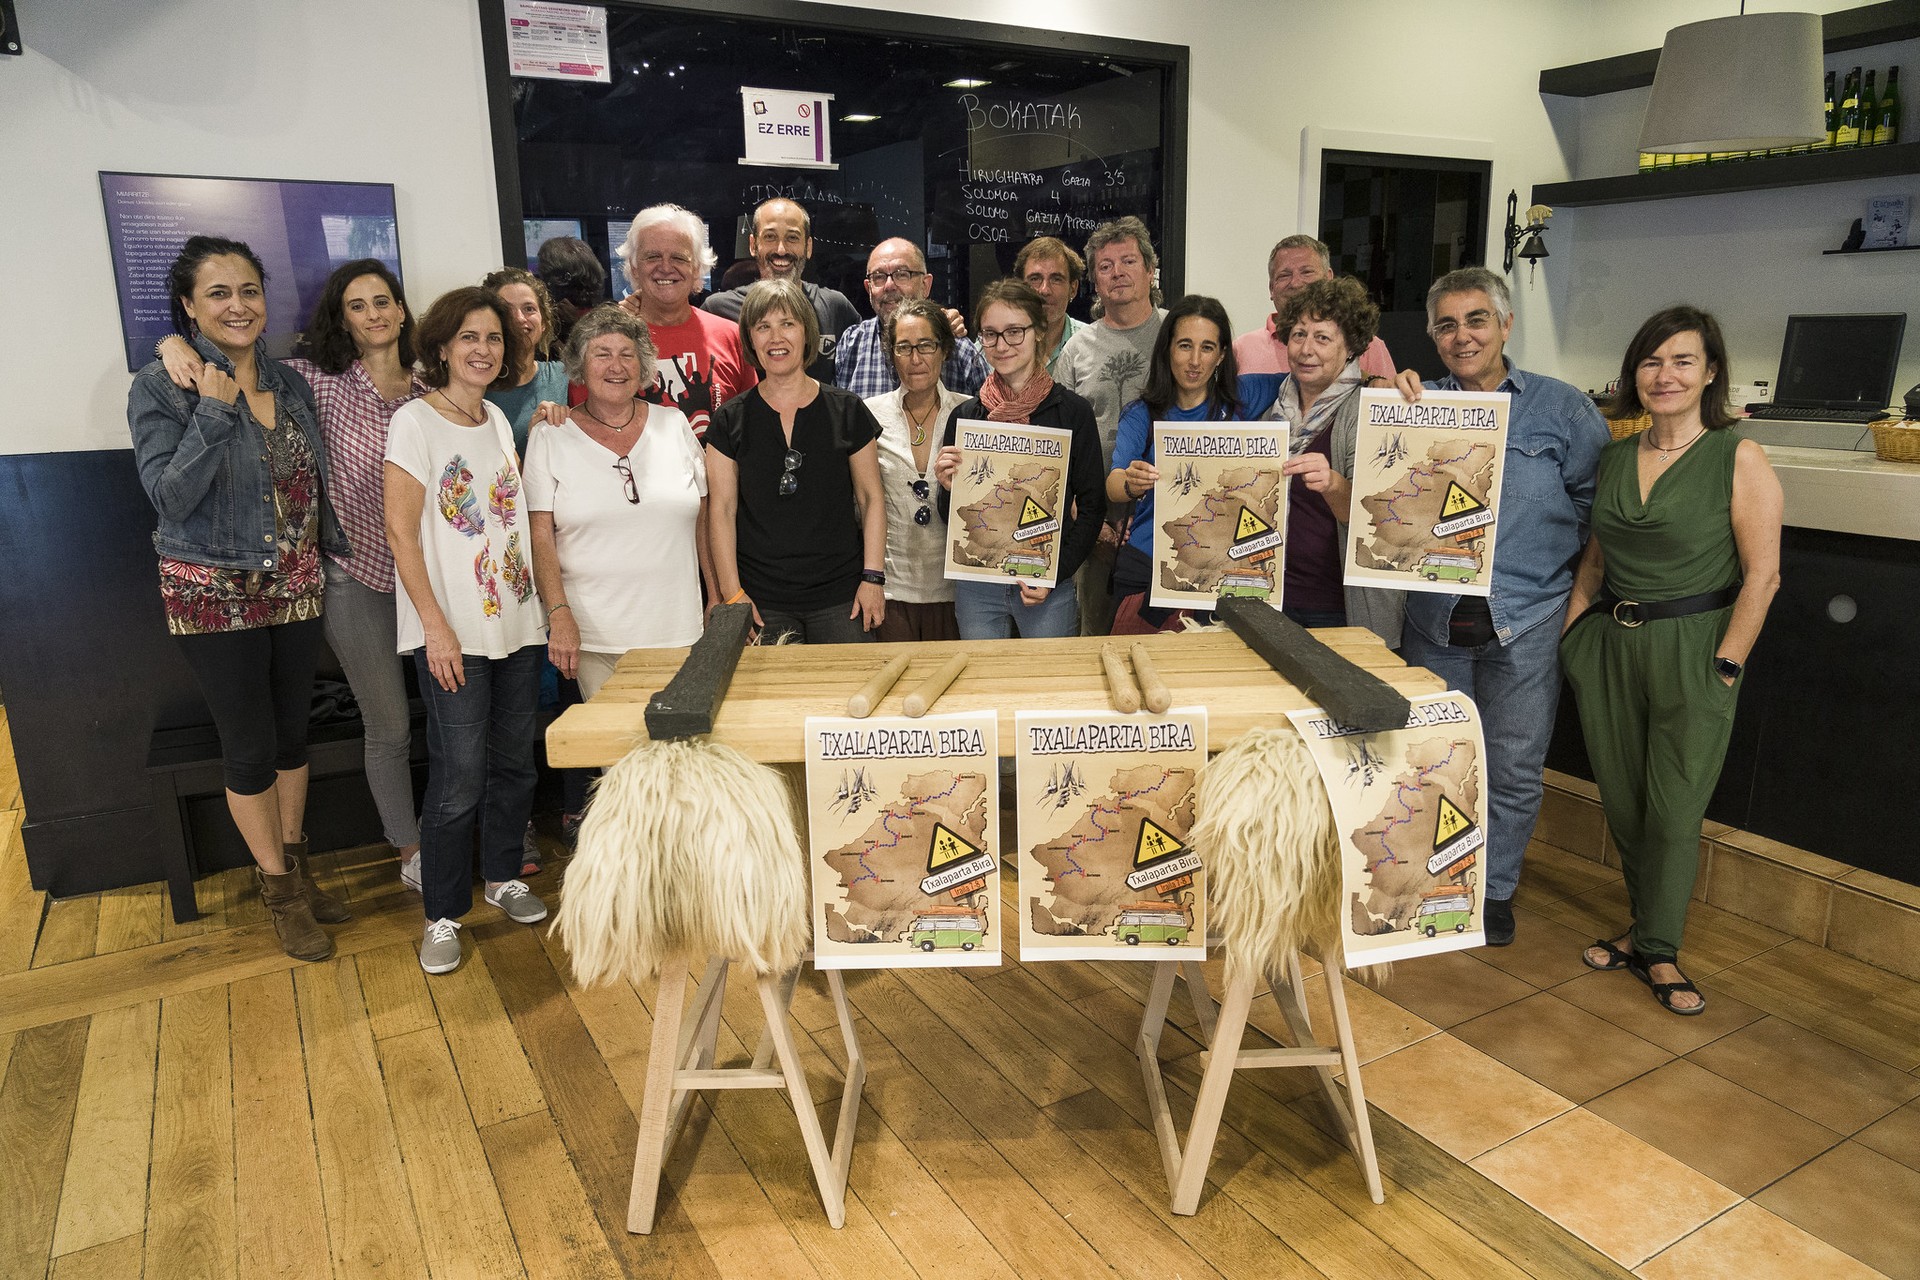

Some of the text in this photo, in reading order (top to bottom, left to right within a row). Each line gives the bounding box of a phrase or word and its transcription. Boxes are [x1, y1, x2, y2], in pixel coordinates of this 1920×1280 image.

[958, 94, 1081, 132] BOKATAK
[758, 123, 810, 136] EZ ERRE
[961, 184, 1061, 205] SOLOMOA 4
[965, 203, 1008, 220] SOLOMO
[968, 223, 1011, 242] OSOA
[1370, 405, 1496, 427] TXALAPARTA BIRA
[964, 432, 1061, 455] TXALAPARTA BIRA
[1164, 436, 1277, 455] TXALAPARTA BIRA
[1016, 521, 1057, 538] Txalaparta Bira
[1436, 513, 1491, 534] Txalaparta Bira
[1232, 535, 1280, 556] Txalaparta Bira
[1419, 702, 1467, 723] BIRA
[820, 729, 983, 756] TXALAPARTA BIRA
[1030, 724, 1193, 751] TXALAPARTA BIRA
[1430, 833, 1480, 869] Txalaparta Bira
[924, 859, 991, 889] Txalaparta Bira
[1130, 857, 1198, 885] Txalaparta Bira
